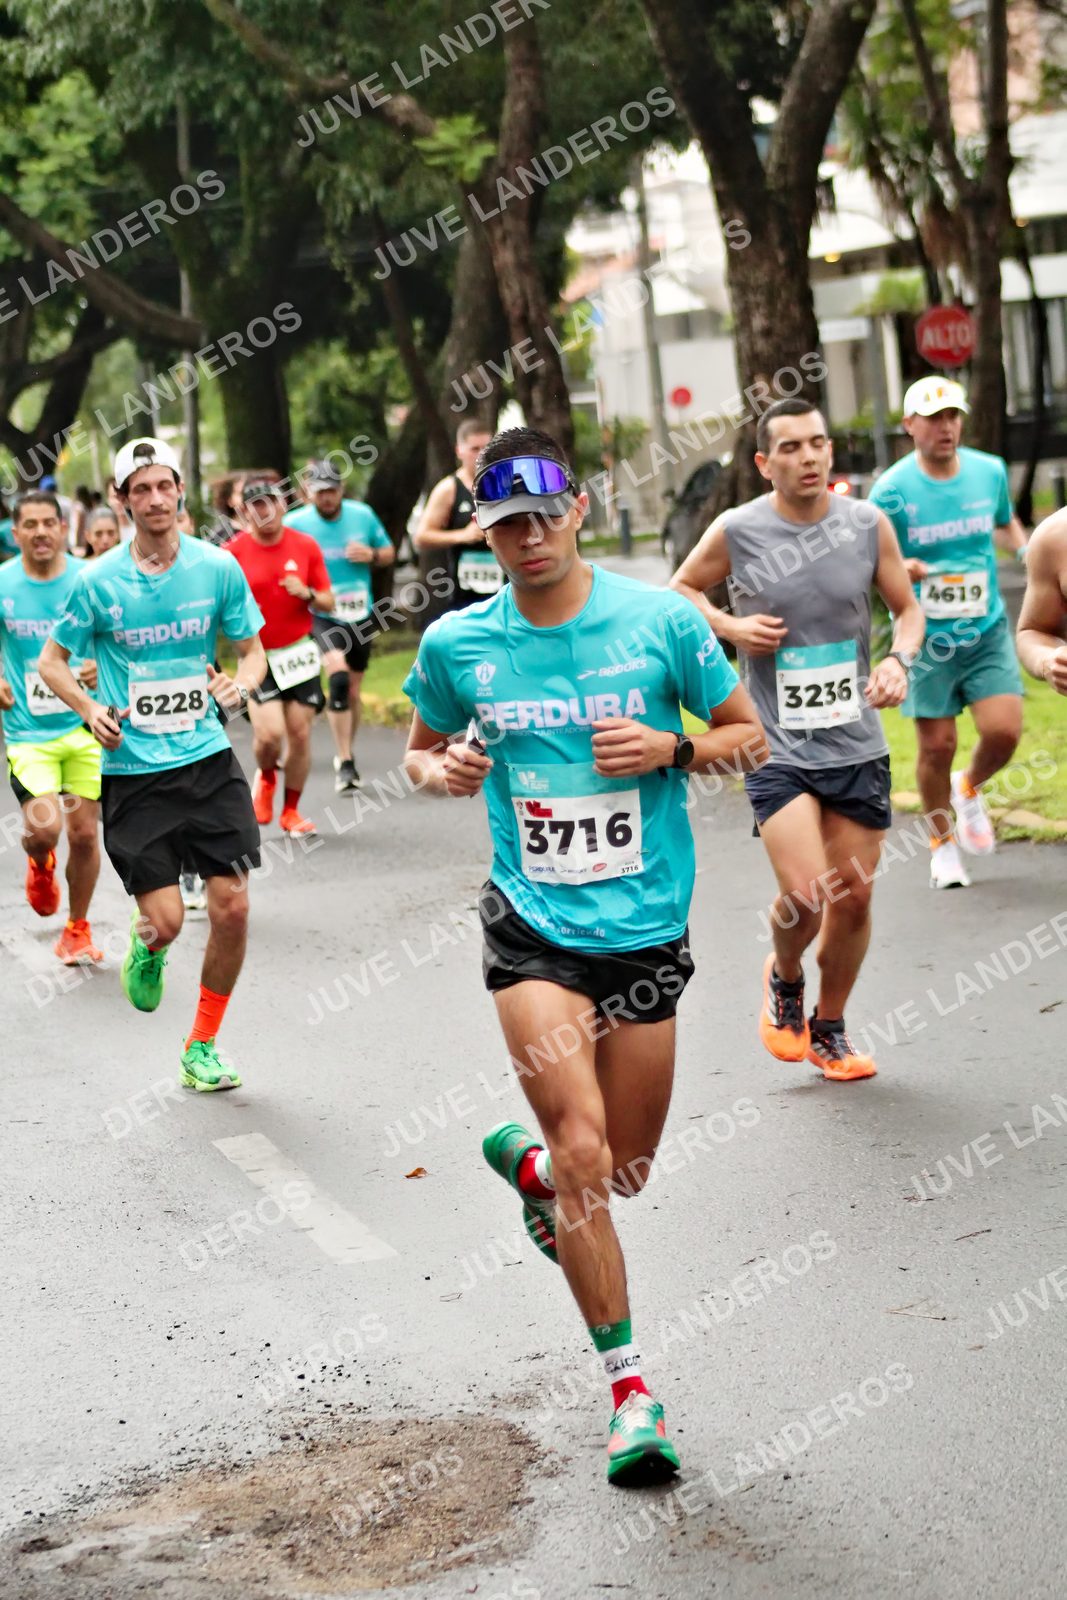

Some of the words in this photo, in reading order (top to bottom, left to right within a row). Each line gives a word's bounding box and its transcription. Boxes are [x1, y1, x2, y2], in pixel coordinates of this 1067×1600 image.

[922, 321, 972, 350] ALTO
[927, 585, 982, 602] 4619
[598, 658, 647, 677] BROOKS
[136, 689, 204, 716] 6228
[784, 678, 852, 709] 3236
[475, 687, 648, 732] PERDURA
[524, 812, 633, 856] 3716
